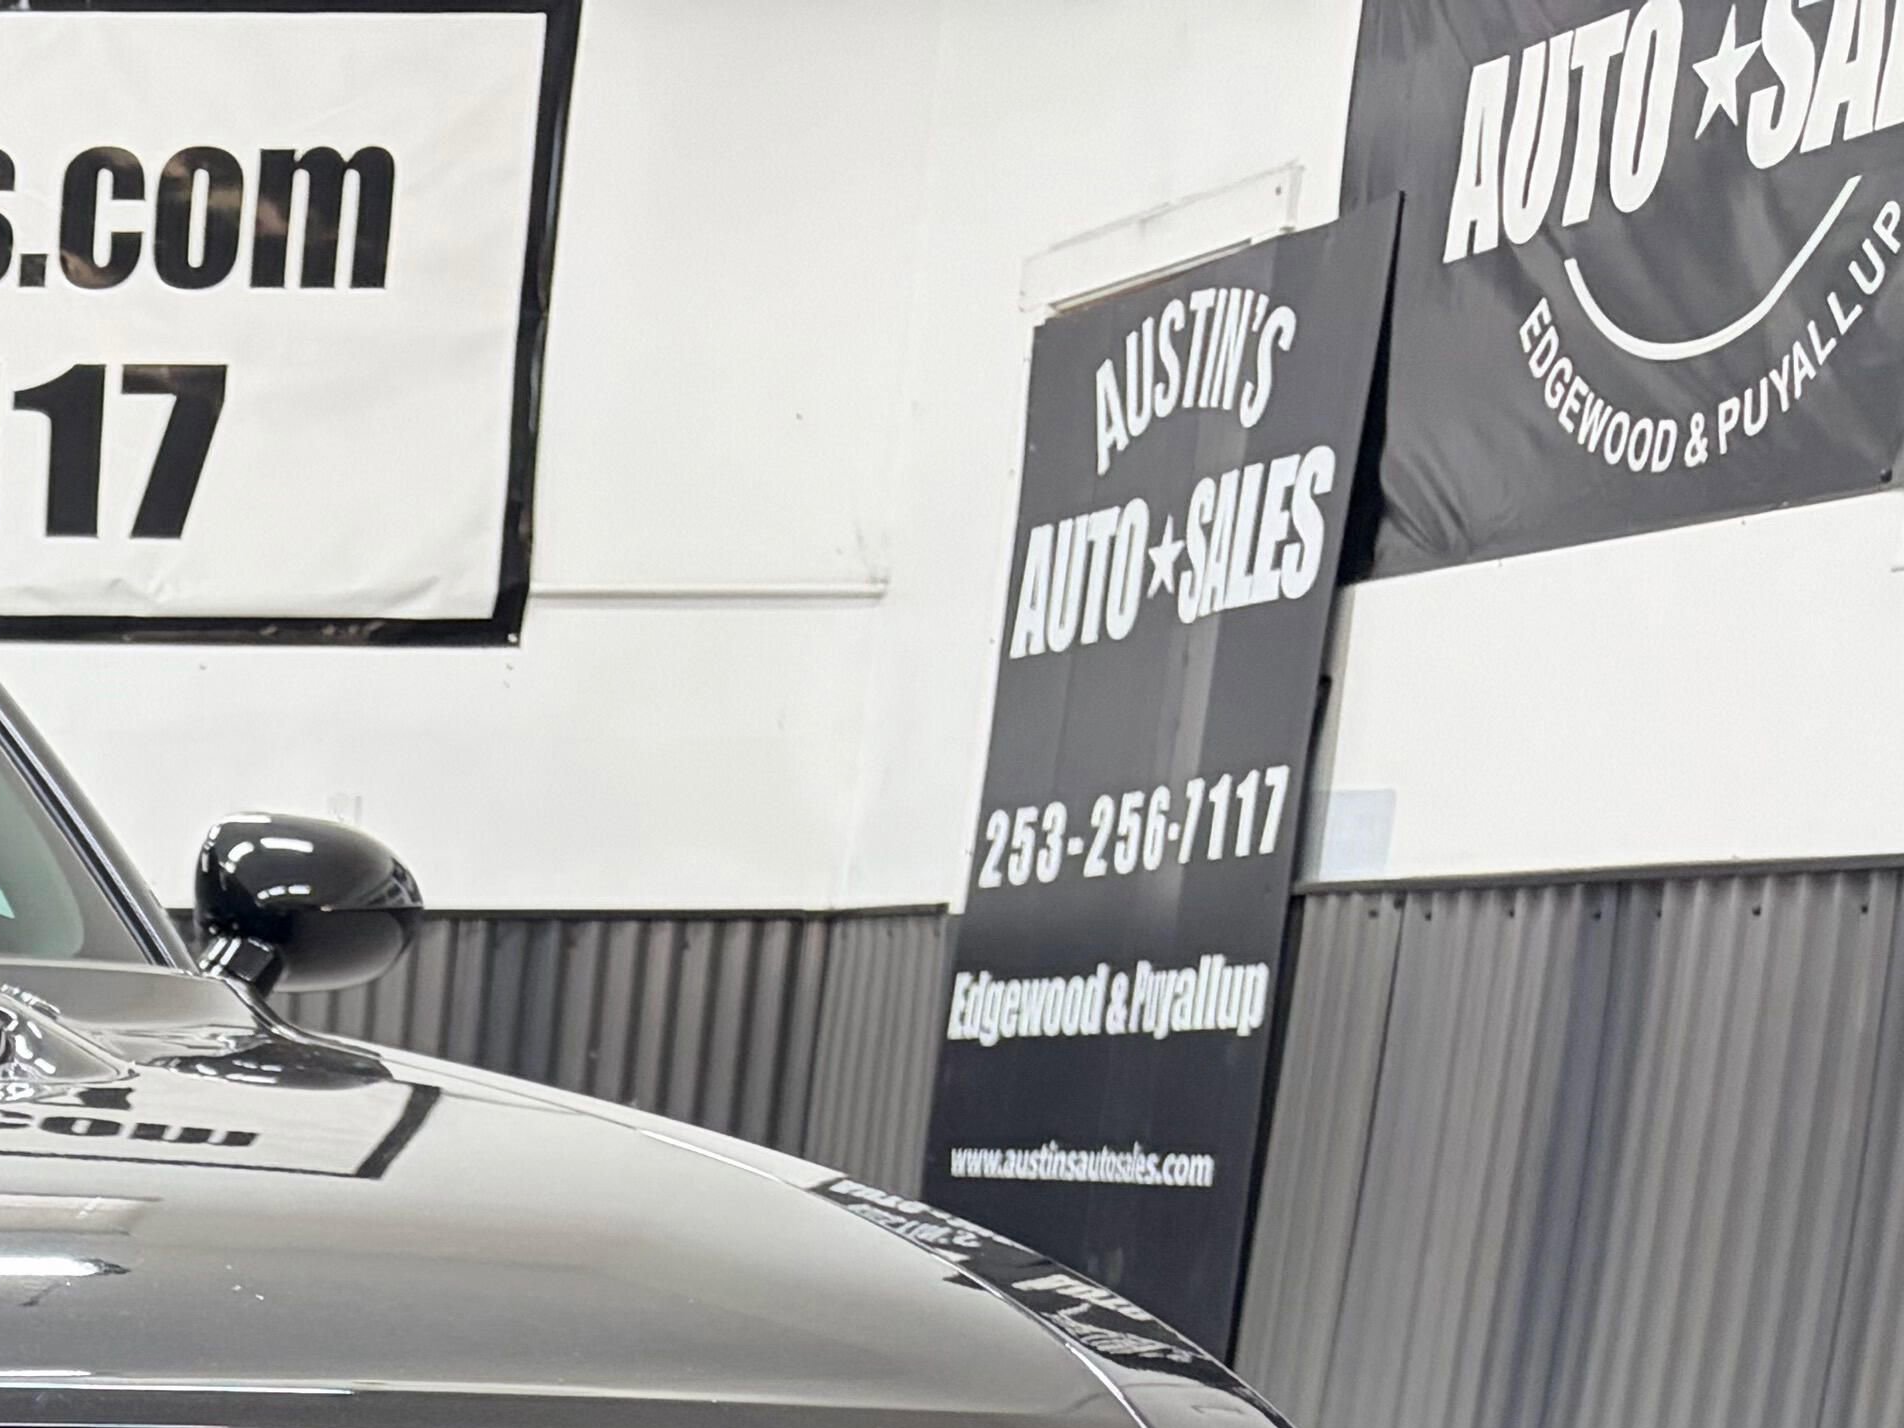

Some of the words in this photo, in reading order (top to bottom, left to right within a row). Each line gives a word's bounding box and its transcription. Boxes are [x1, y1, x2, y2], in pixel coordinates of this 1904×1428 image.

[1443, 0, 1683, 263] AUTO
[1093, 287, 1298, 476] AUSTIN'S
[1519, 297, 1678, 473] EDGEWOOD
[1684, 412, 1708, 468] &
[1718, 200, 1902, 454] PUYALLUP
[1010, 498, 1148, 660] AUTO
[1178, 445, 1337, 624] SALES
[979, 765, 1289, 888] 253-256-7117
[947, 963, 1109, 1047] Edgewood
[1106, 973, 1130, 1034] &
[1128, 954, 1269, 1039] Puyallup
[951, 1139, 1215, 1187] www.austinsautosales.com
